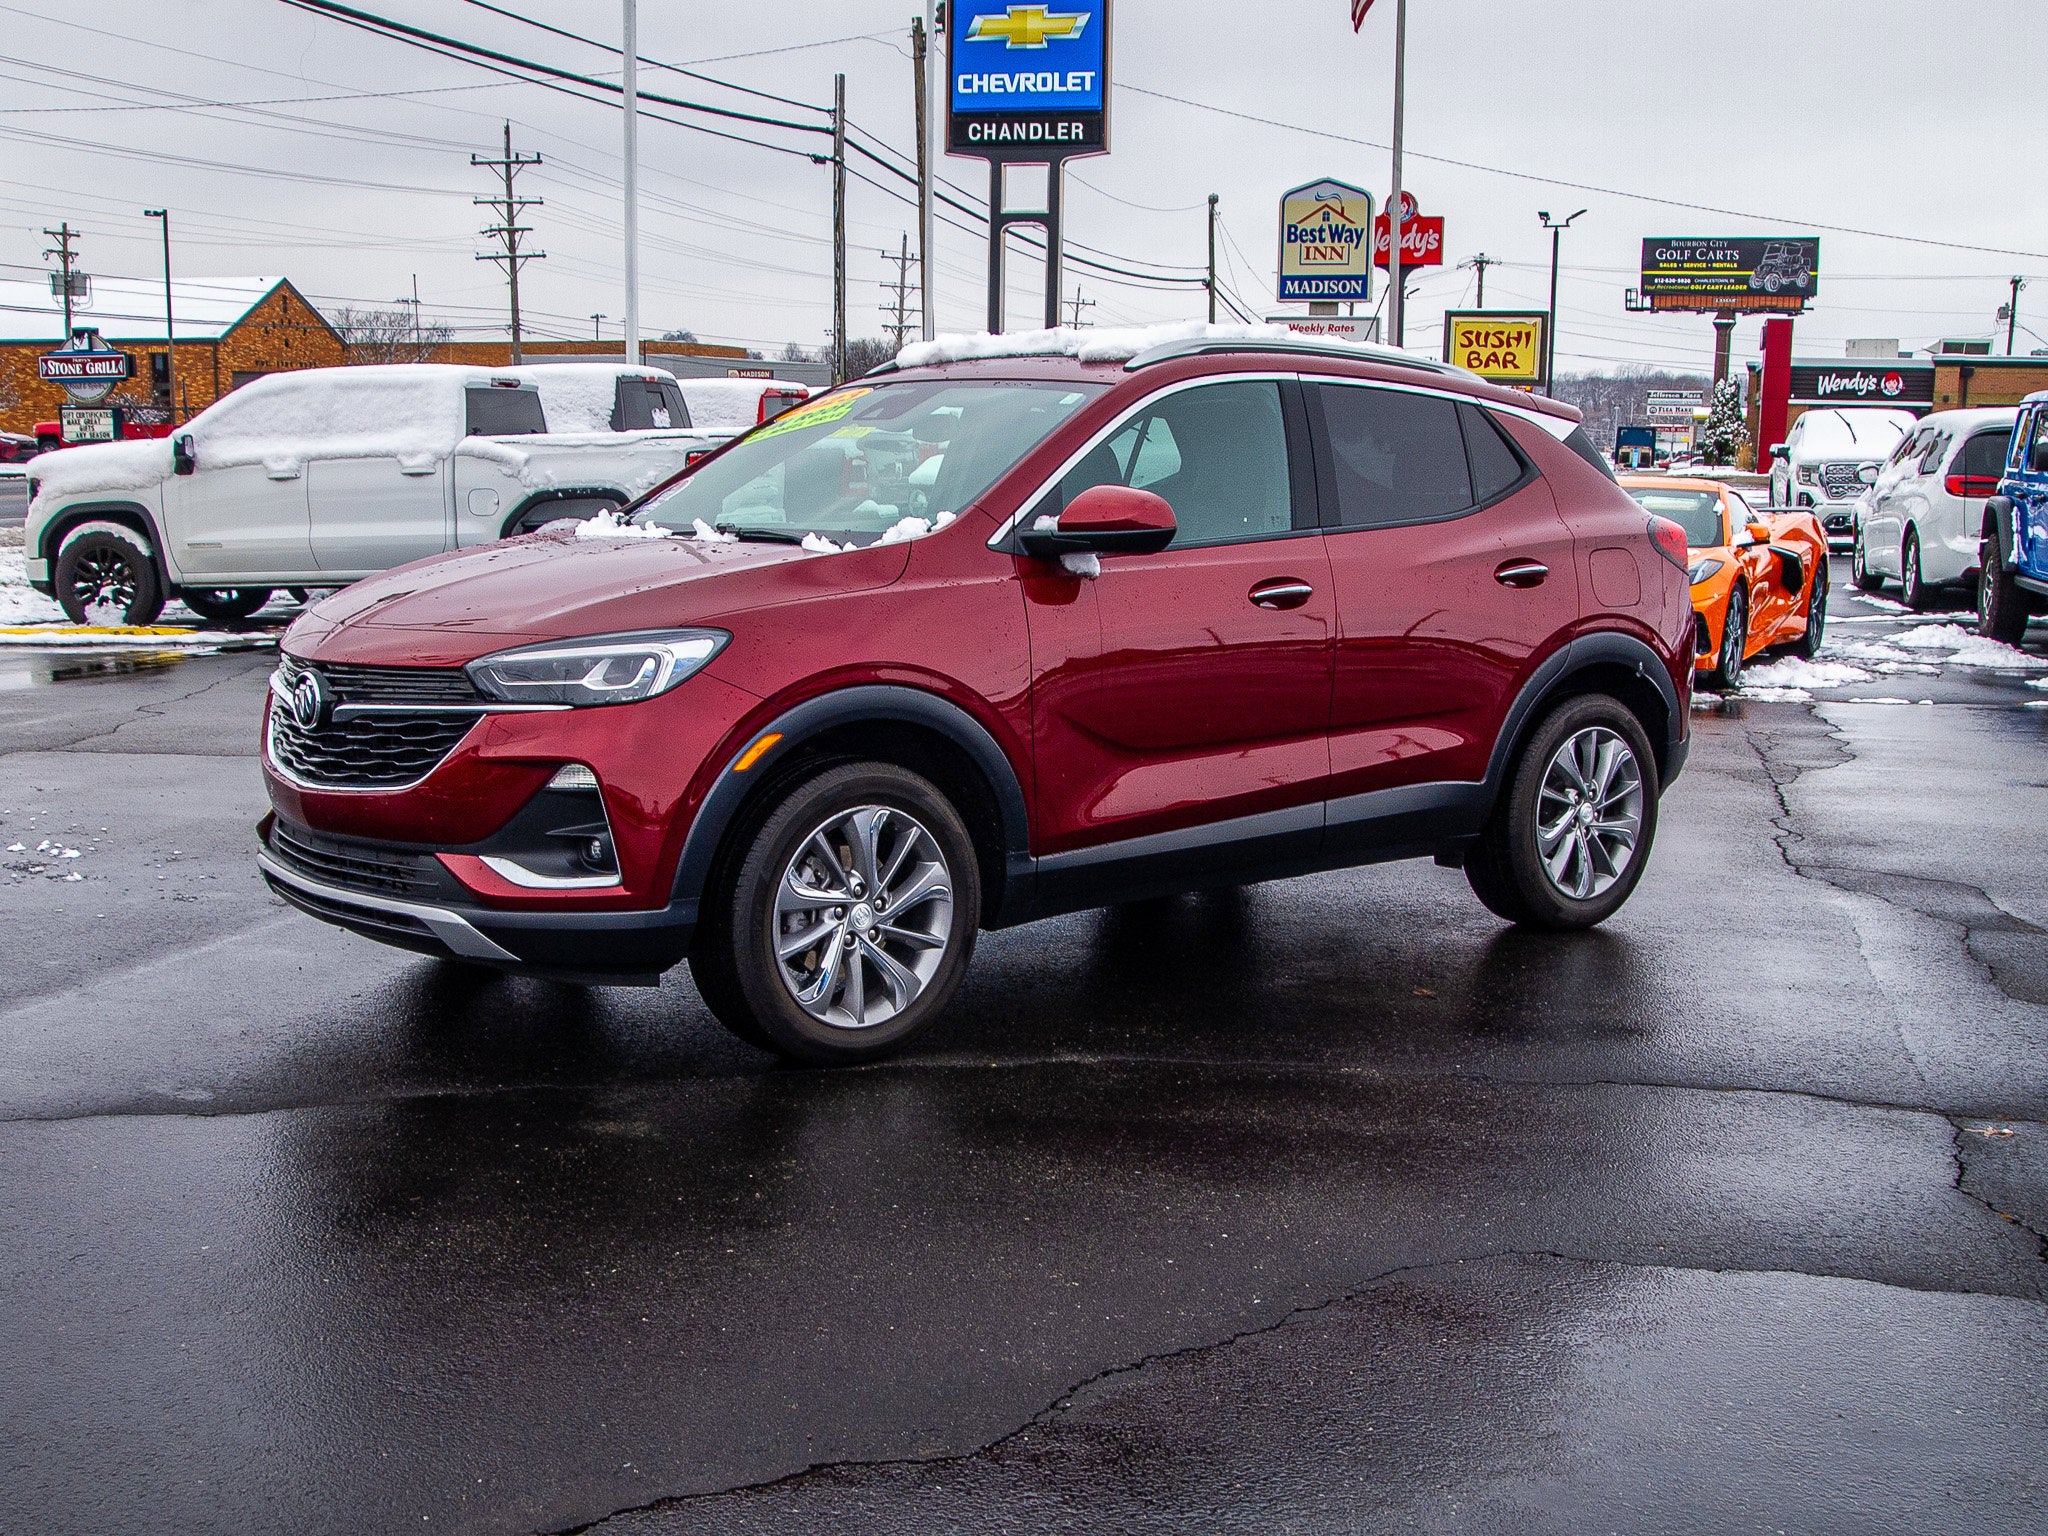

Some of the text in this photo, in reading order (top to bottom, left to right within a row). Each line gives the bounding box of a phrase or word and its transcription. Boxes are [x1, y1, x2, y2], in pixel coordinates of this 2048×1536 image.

[957, 71, 1096, 94] CHEVROLET
[968, 122, 1084, 141] CHANDLER
[1286, 223, 1365, 249] Best Way
[1373, 222, 1439, 258] edy's
[1671, 239, 1728, 248] BOURBON CITY
[1303, 245, 1345, 261] INN
[1655, 248, 1740, 261] GOLF CARTS
[1284, 280, 1363, 294] MADISON
[1288, 322, 1355, 335] Weekly Rates
[1459, 330, 1532, 349] SUSHI
[47, 360, 118, 375] STONE GRILL
[1466, 350, 1521, 369] BAR
[740, 370, 770, 378] MADISON
[1817, 371, 1878, 396] Wendy's
